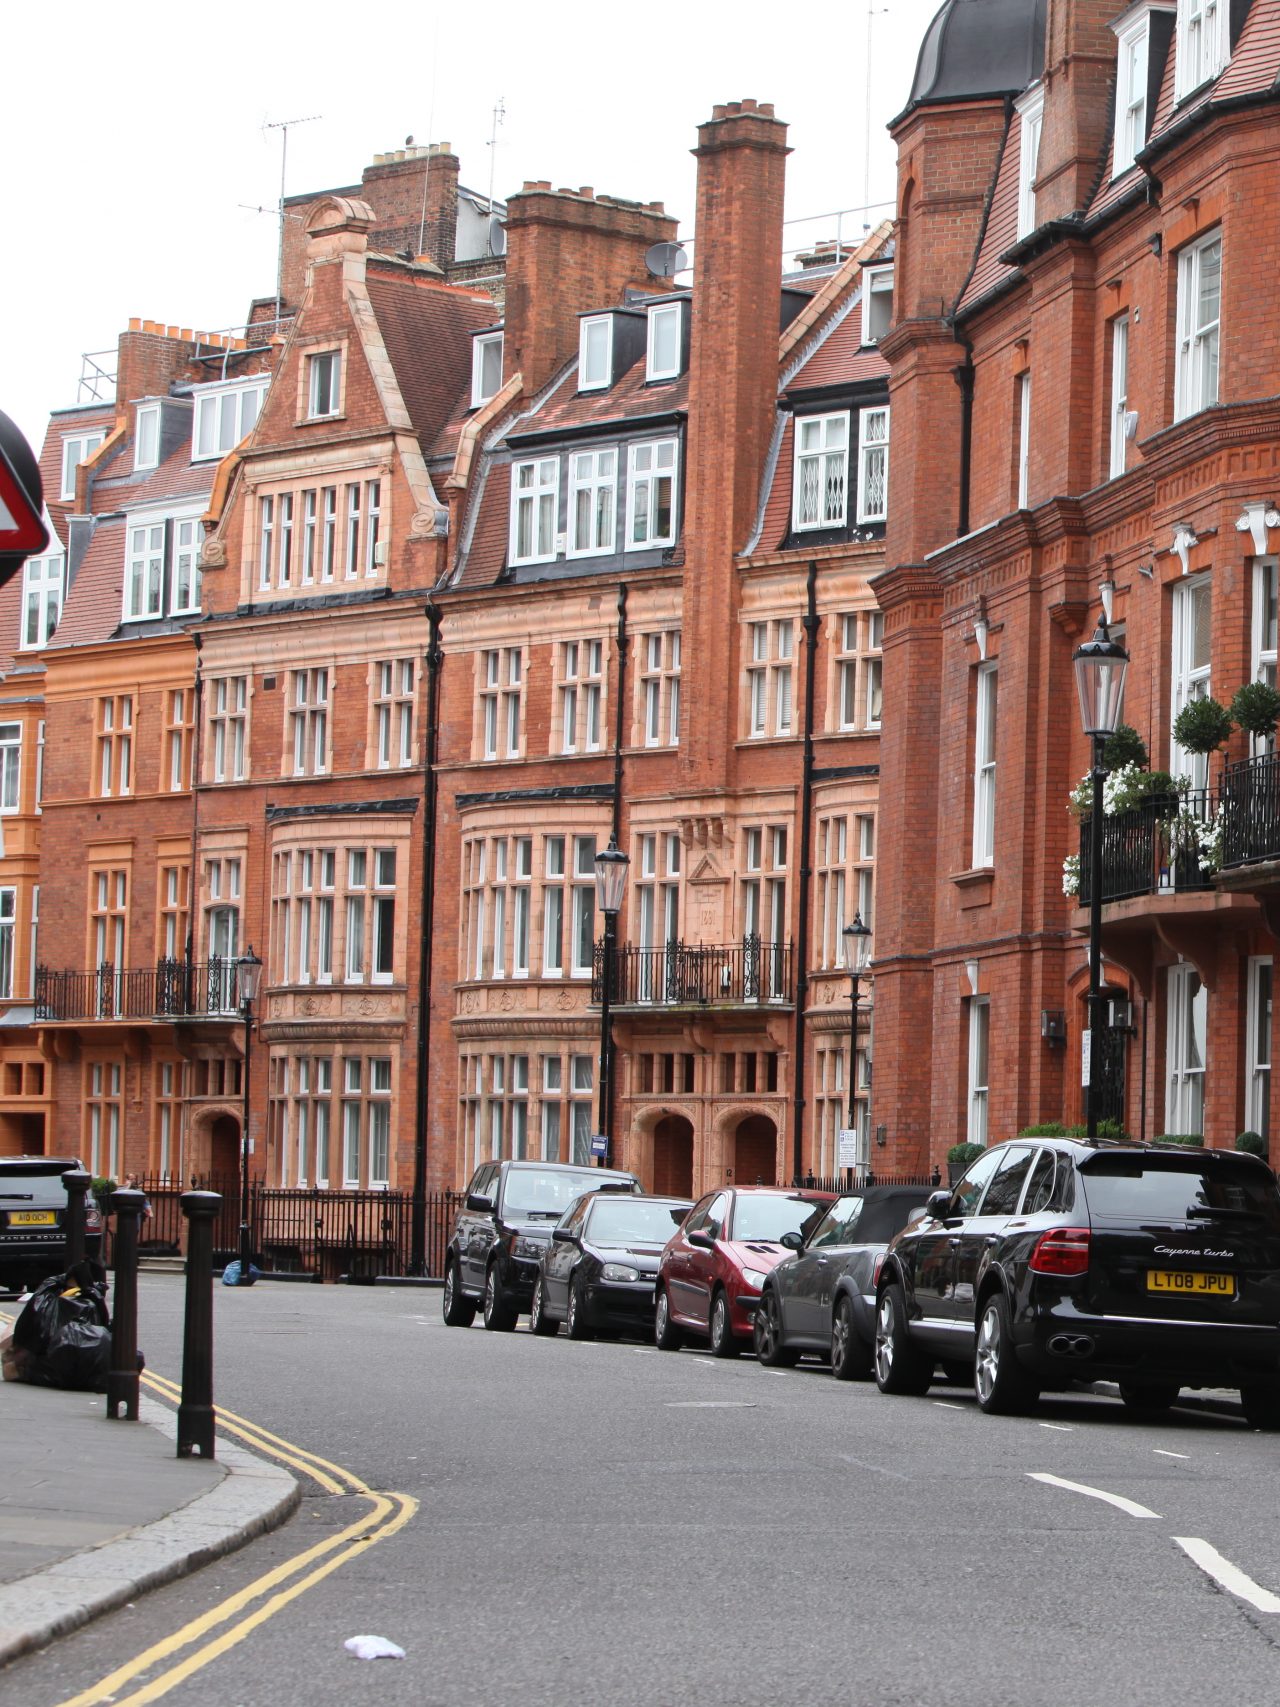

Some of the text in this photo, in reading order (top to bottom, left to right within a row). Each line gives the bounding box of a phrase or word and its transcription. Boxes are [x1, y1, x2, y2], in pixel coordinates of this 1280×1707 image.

[726, 1169, 732, 1177] 12
[1153, 1245, 1234, 1257] Cayenne turbo
[1154, 1272, 1227, 1290] LT08 JPU
